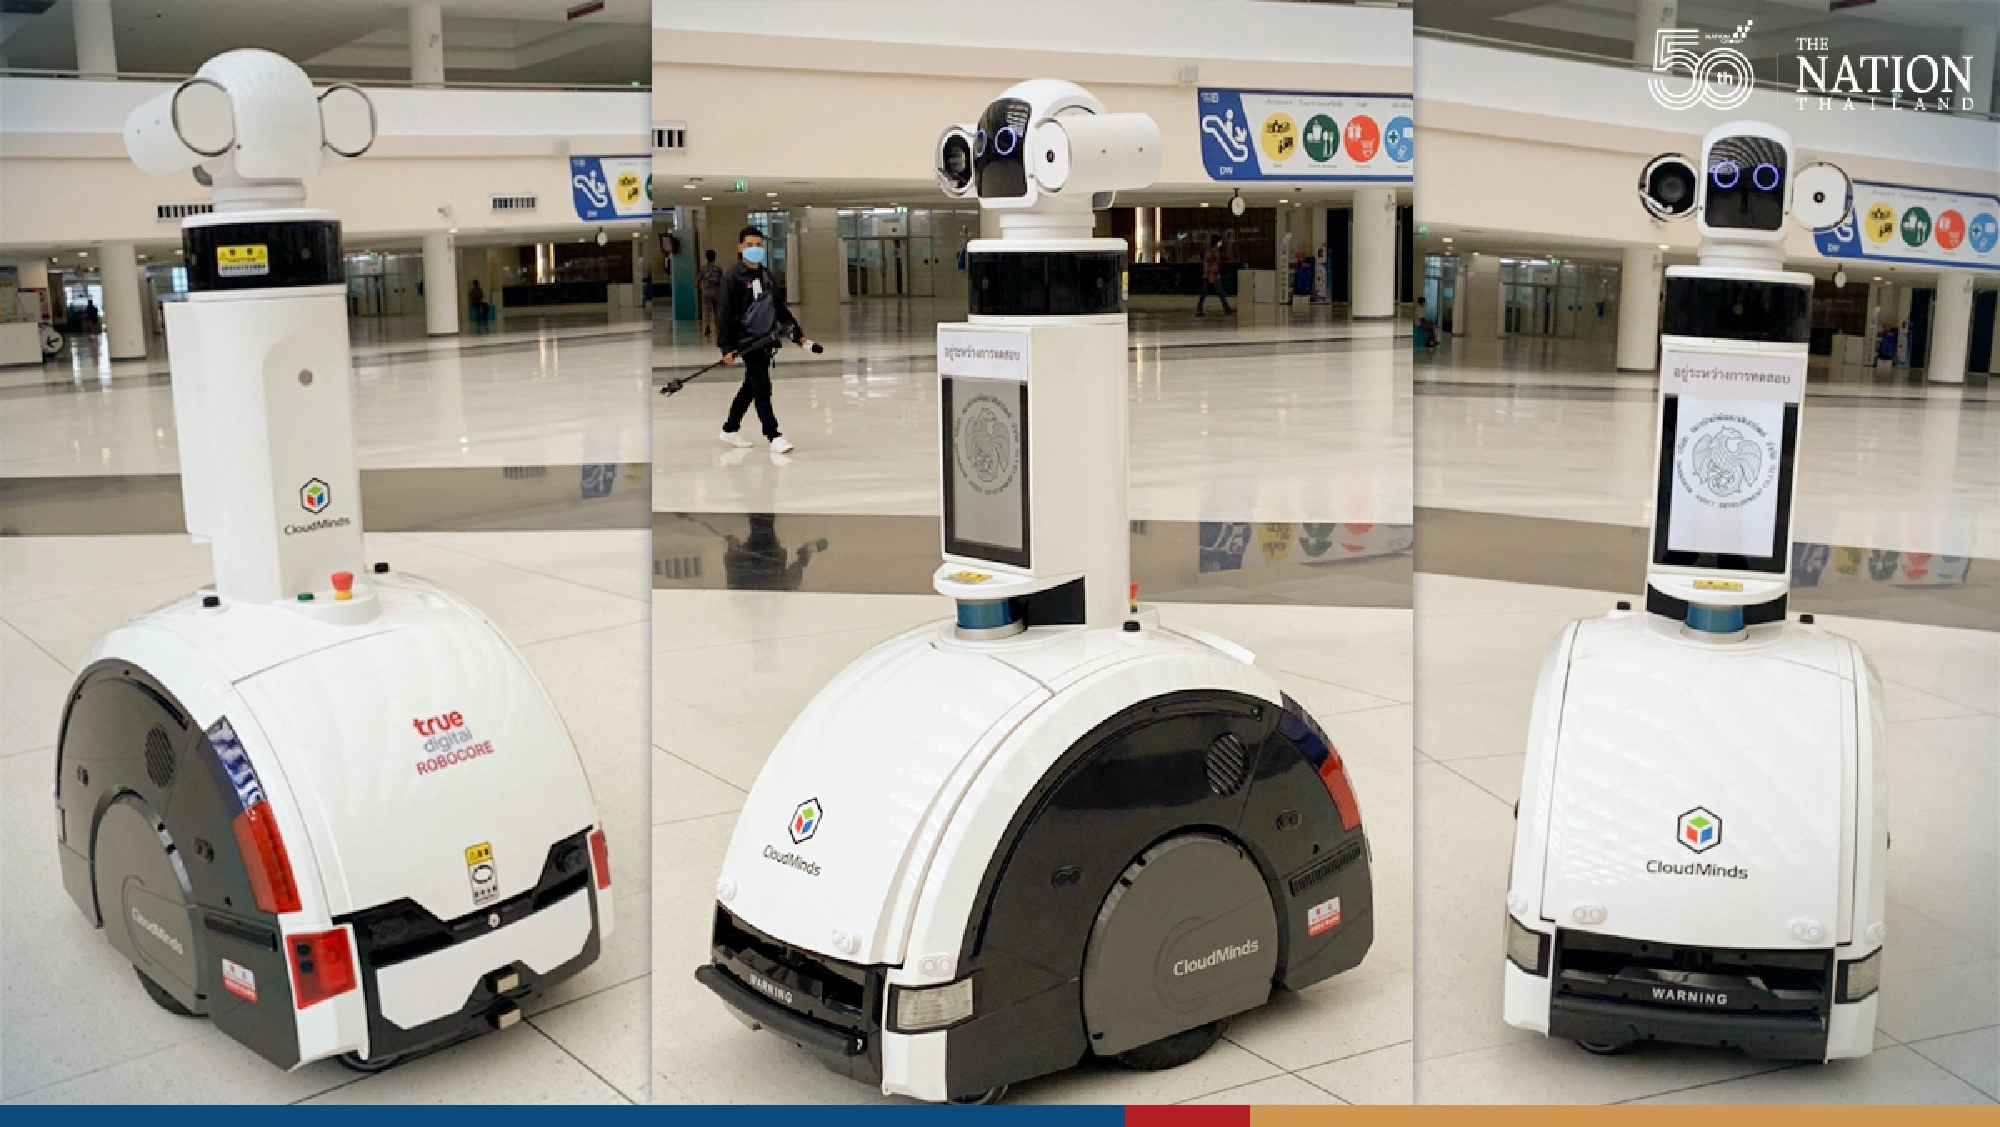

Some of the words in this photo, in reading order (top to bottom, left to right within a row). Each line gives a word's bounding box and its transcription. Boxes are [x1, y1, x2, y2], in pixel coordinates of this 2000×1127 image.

[284, 517, 351, 536] CloudMinds
[413, 711, 464, 737] true
[423, 725, 473, 752] digital
[416, 740, 494, 775] ROBOCORE
[763, 844, 821, 877] CloudMinds
[1645, 859, 1749, 880] CloudMinds
[1172, 940, 1259, 976] CloudMinds
[749, 973, 793, 1004] WARNING
[1652, 986, 1728, 1005] WARNING
